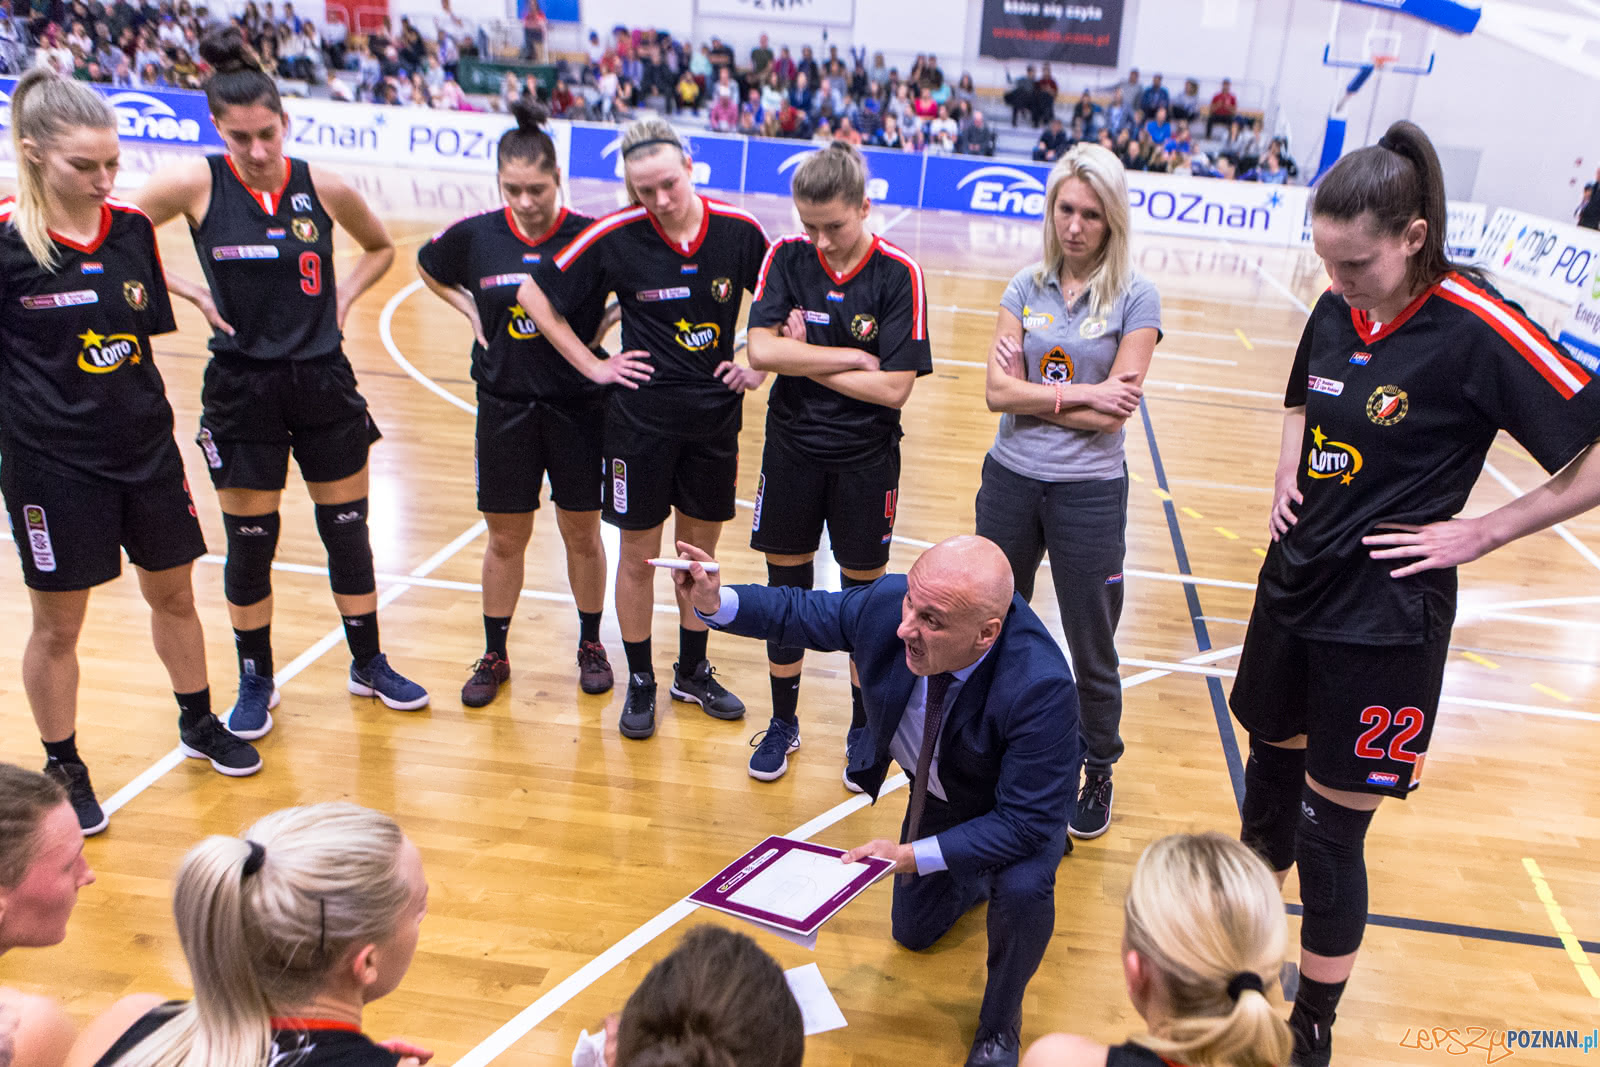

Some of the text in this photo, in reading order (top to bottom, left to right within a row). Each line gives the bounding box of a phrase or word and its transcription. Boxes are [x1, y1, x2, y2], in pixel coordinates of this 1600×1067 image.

[299, 250, 322, 296] 9
[684, 328, 713, 347] LOTTO
[89, 341, 132, 368] LOTTO
[1311, 448, 1348, 472] LOTTO
[1354, 705, 1425, 764] 22
